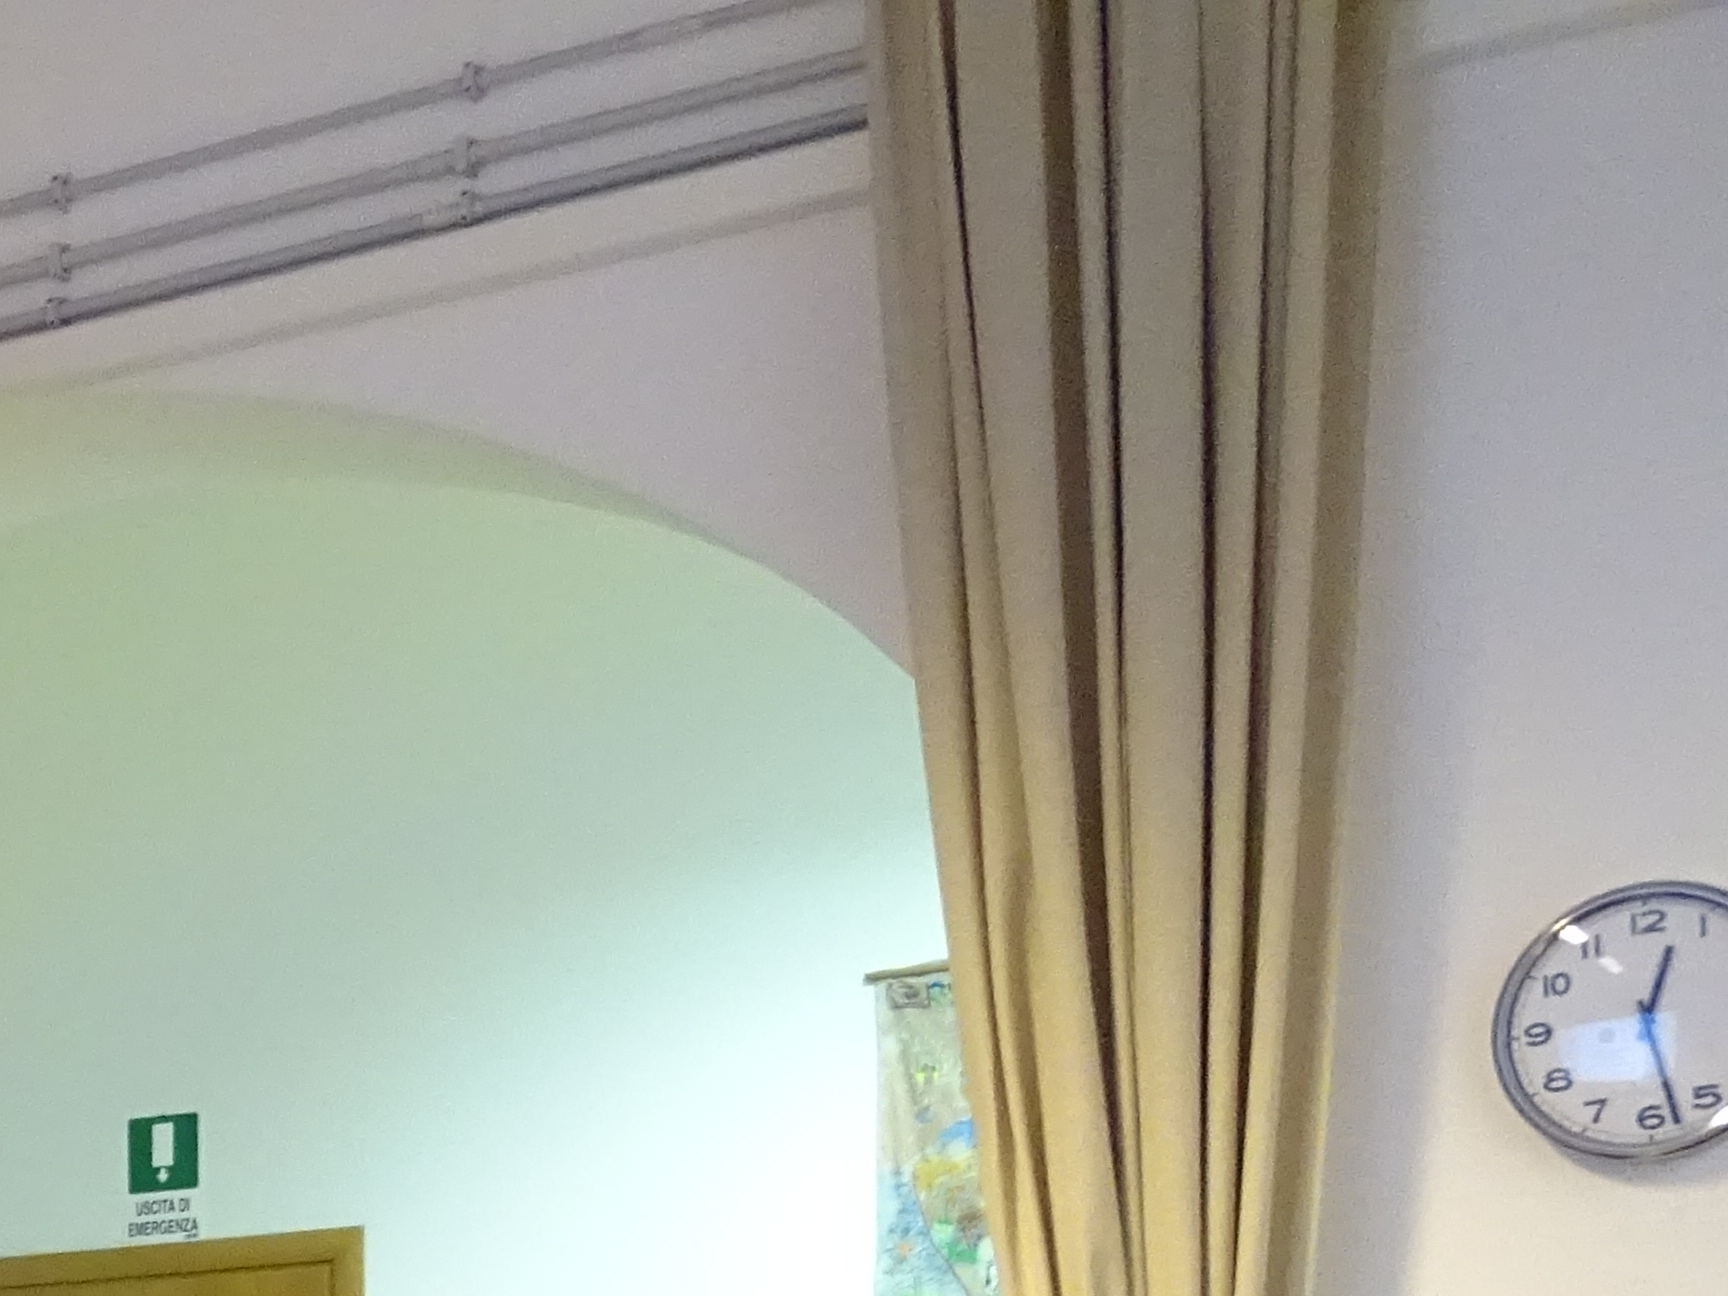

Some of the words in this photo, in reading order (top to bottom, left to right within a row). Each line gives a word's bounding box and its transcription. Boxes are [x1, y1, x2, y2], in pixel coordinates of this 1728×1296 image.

[1630, 909, 1667, 936] 12
[1698, 913, 1708, 938] 1
[1579, 933, 1601, 959] 11
[1543, 971, 1571, 998] 10
[1523, 1021, 1553, 1047] 9
[1543, 1067, 1574, 1093] 8
[1692, 1083, 1723, 1110] 5
[1582, 1097, 1609, 1125] 7
[1635, 1105, 1666, 1131] 6
[136, 1199, 175, 1217] USCITA
[178, 1197, 191, 1213] DI
[128, 1217, 199, 1238] EMERGENZA
